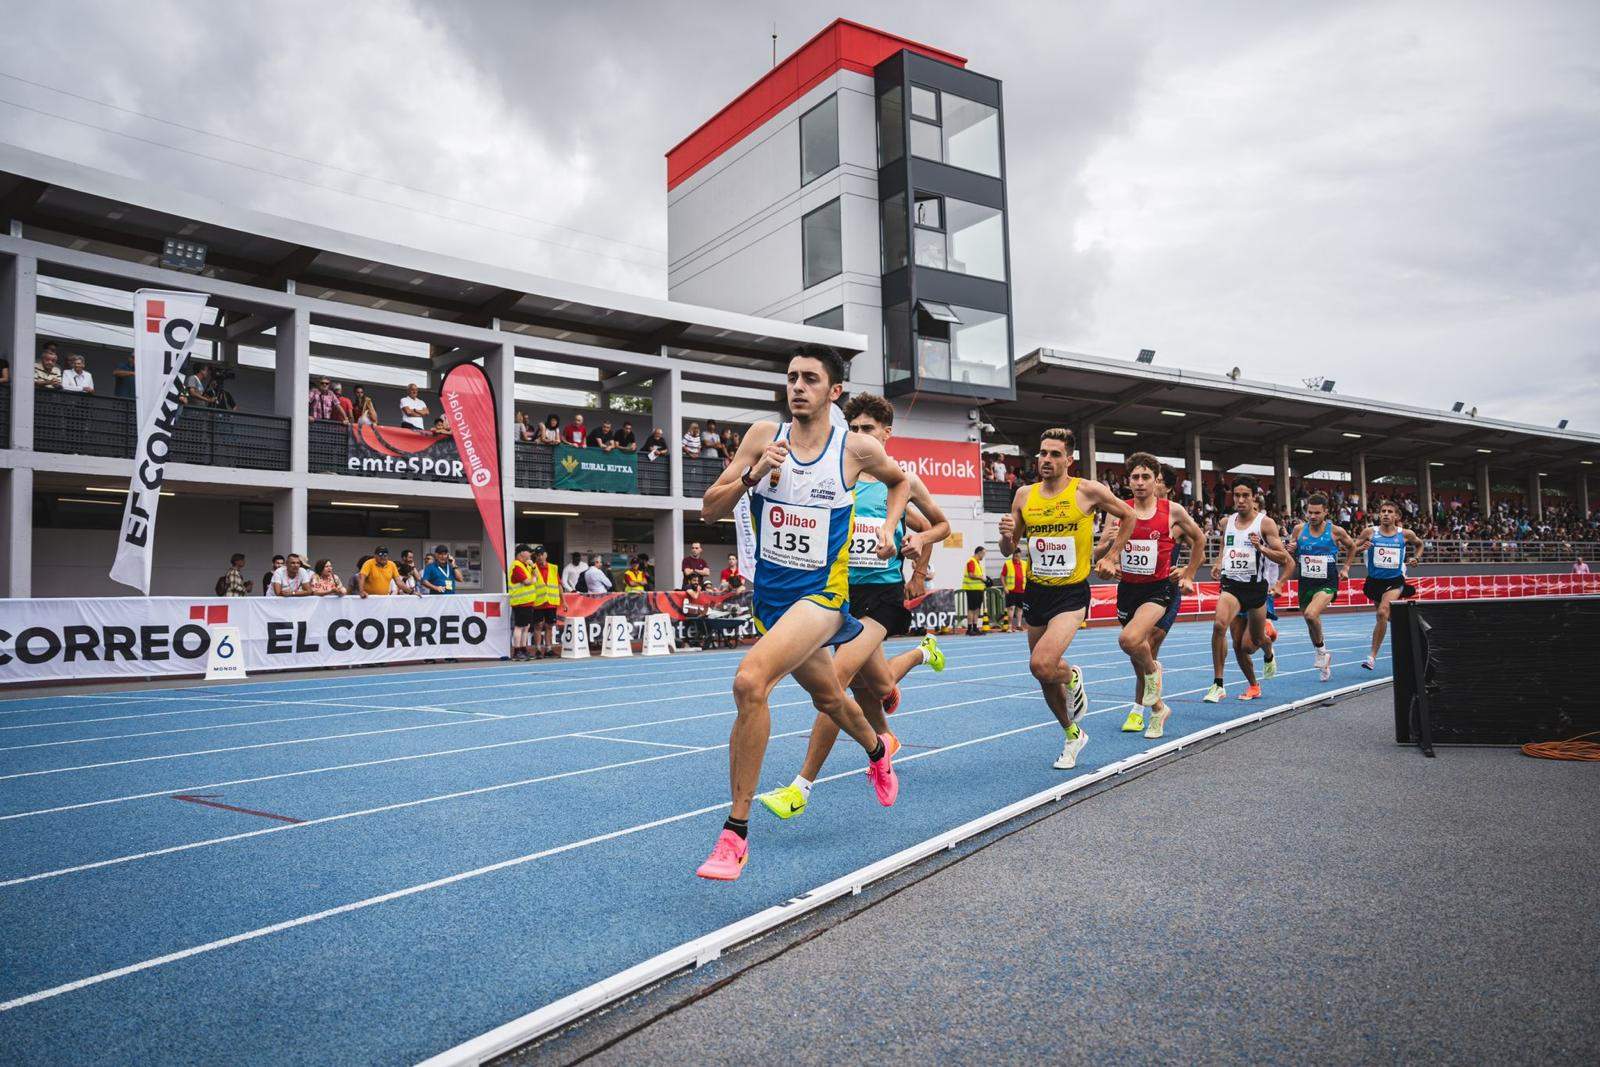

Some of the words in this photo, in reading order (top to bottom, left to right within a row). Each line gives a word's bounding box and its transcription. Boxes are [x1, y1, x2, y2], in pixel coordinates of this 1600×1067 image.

[581, 462, 606, 472] RURAL
[607, 464, 633, 474] KUTXA
[769, 506, 817, 529] Bilbao
[773, 531, 810, 554] 135
[1036, 538, 1067, 552] Bilbao
[1041, 554, 1066, 567] 174
[1126, 555, 1149, 566] 230
[1230, 560, 1248, 569] 152
[1306, 565, 1321, 573] 143
[266, 621, 319, 654] EL
[327, 615, 488, 652] CORREO
[565, 624, 573, 642] 5
[577, 624, 585, 642] 5
[616, 623, 626, 642] 2
[653, 622, 662, 641] 3
[217, 635, 234, 658] 6
